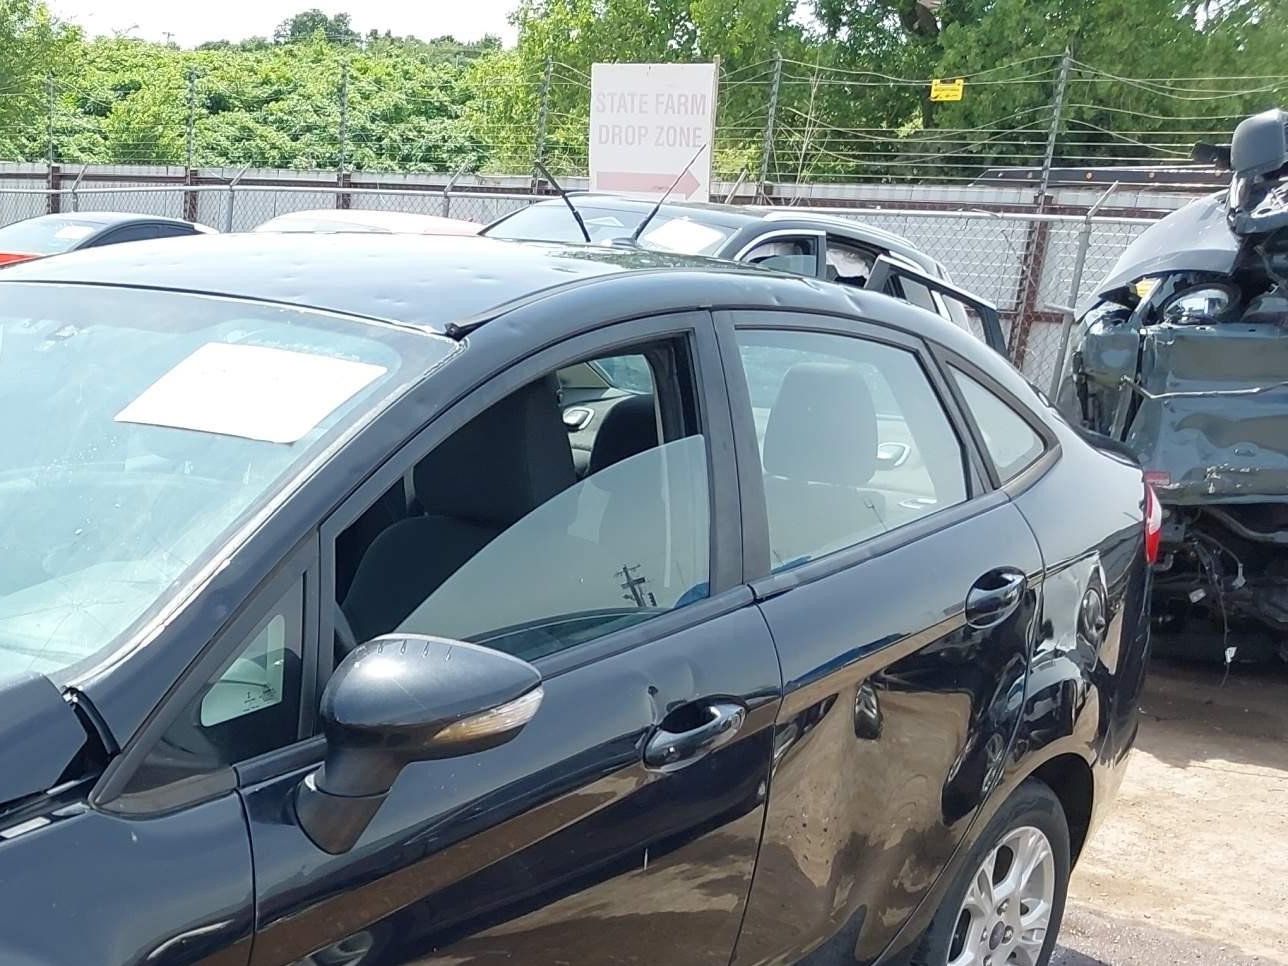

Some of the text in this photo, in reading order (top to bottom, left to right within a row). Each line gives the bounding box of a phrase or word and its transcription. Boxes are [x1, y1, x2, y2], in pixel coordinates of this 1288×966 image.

[595, 92, 707, 115] STATE FARM
[598, 124, 702, 148] DROP ZONE
